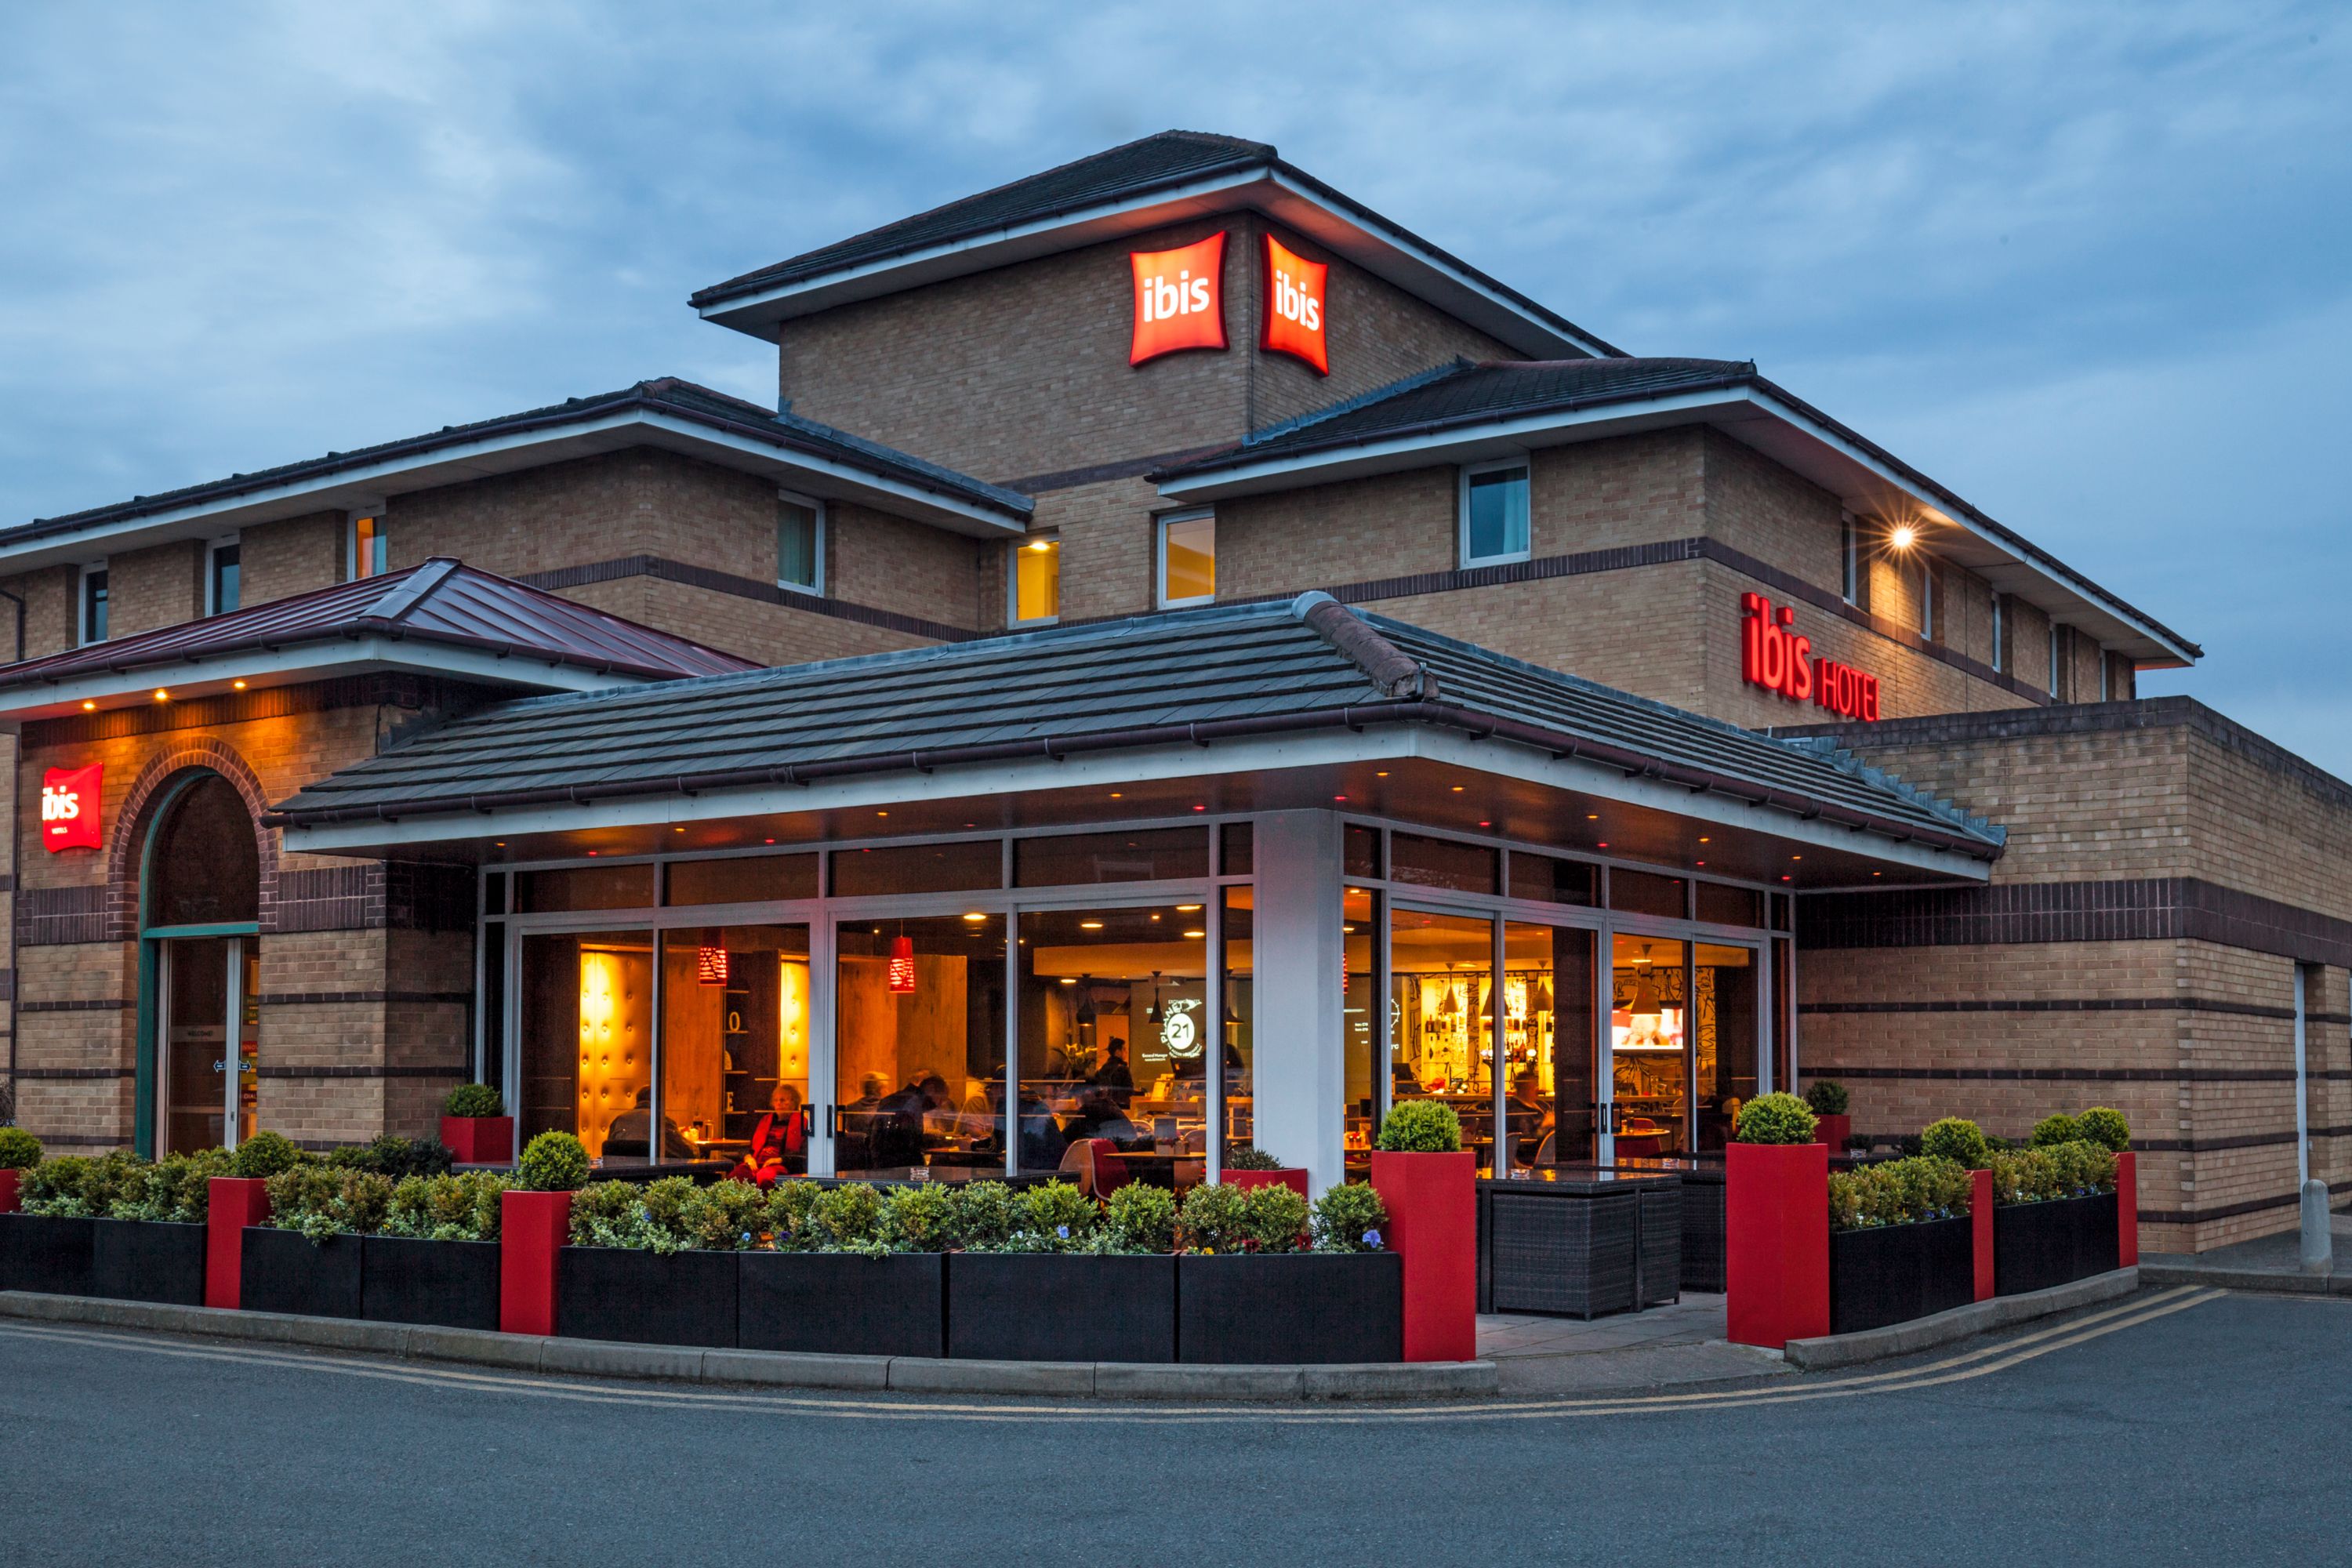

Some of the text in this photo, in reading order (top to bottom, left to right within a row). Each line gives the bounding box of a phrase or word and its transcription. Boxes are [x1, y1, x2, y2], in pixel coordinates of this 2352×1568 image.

[1143, 270, 1210, 322] ibis
[1276, 270, 1319, 331] ibis
[1741, 592, 1812, 700] ibis
[42, 785, 79, 821] ibis
[1171, 1023, 1189, 1039] 21
